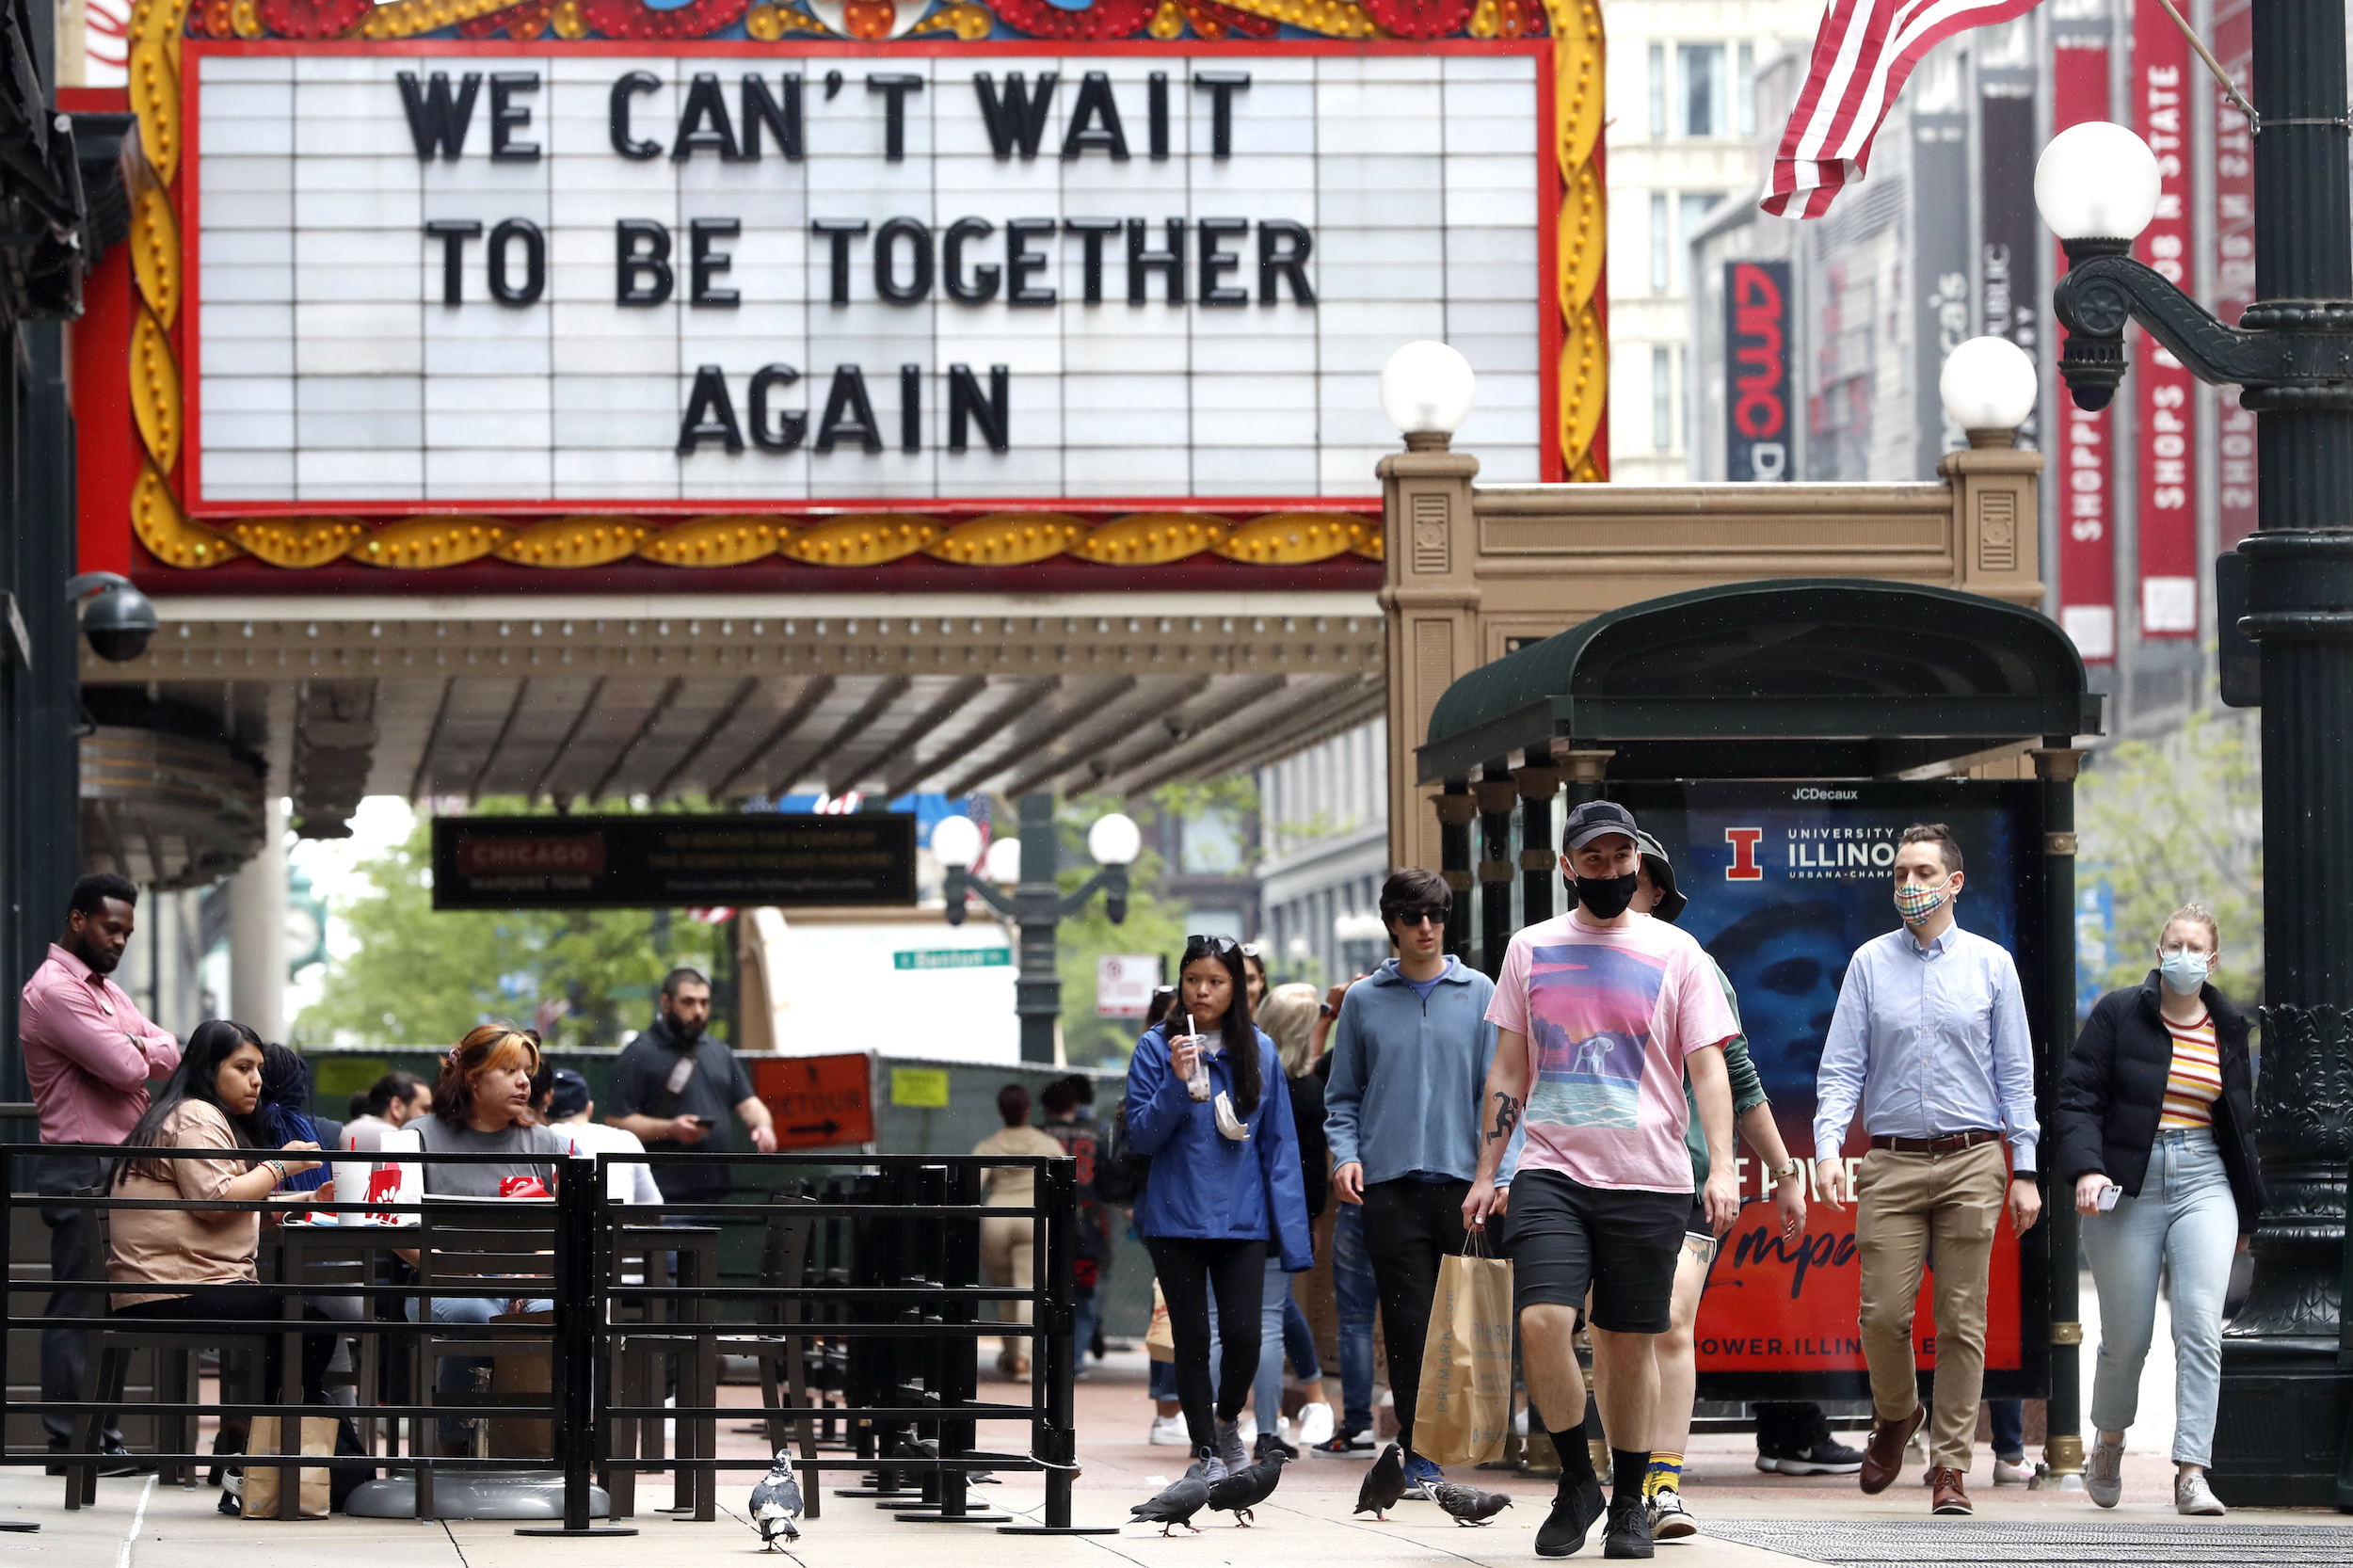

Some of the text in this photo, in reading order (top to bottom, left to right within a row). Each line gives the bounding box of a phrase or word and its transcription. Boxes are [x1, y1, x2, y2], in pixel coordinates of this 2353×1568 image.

[397, 71, 1252, 163] WE CAN'T WAIT
[2146, 65, 2182, 178] STATE
[424, 217, 1318, 309] TO BE TOGETHER
[1734, 262, 1785, 440] amc
[677, 363, 1011, 456] AGAIN
[2153, 384, 2186, 510] SHOPS
[1751, 441, 1786, 481] D
[2070, 408, 2104, 543] SHOPPI
[1788, 827, 1895, 840] UNIVERSITY
[1792, 787, 1858, 801] JCDecaux
[472, 843, 589, 866] CHICAGO
[1789, 841, 1896, 868] ILLINO
[1789, 870, 1893, 879] URBANA-CHAMP
[1762, 1157, 1864, 1203] POWE
[1436, 1289, 1455, 1414] PRIMARK.com
